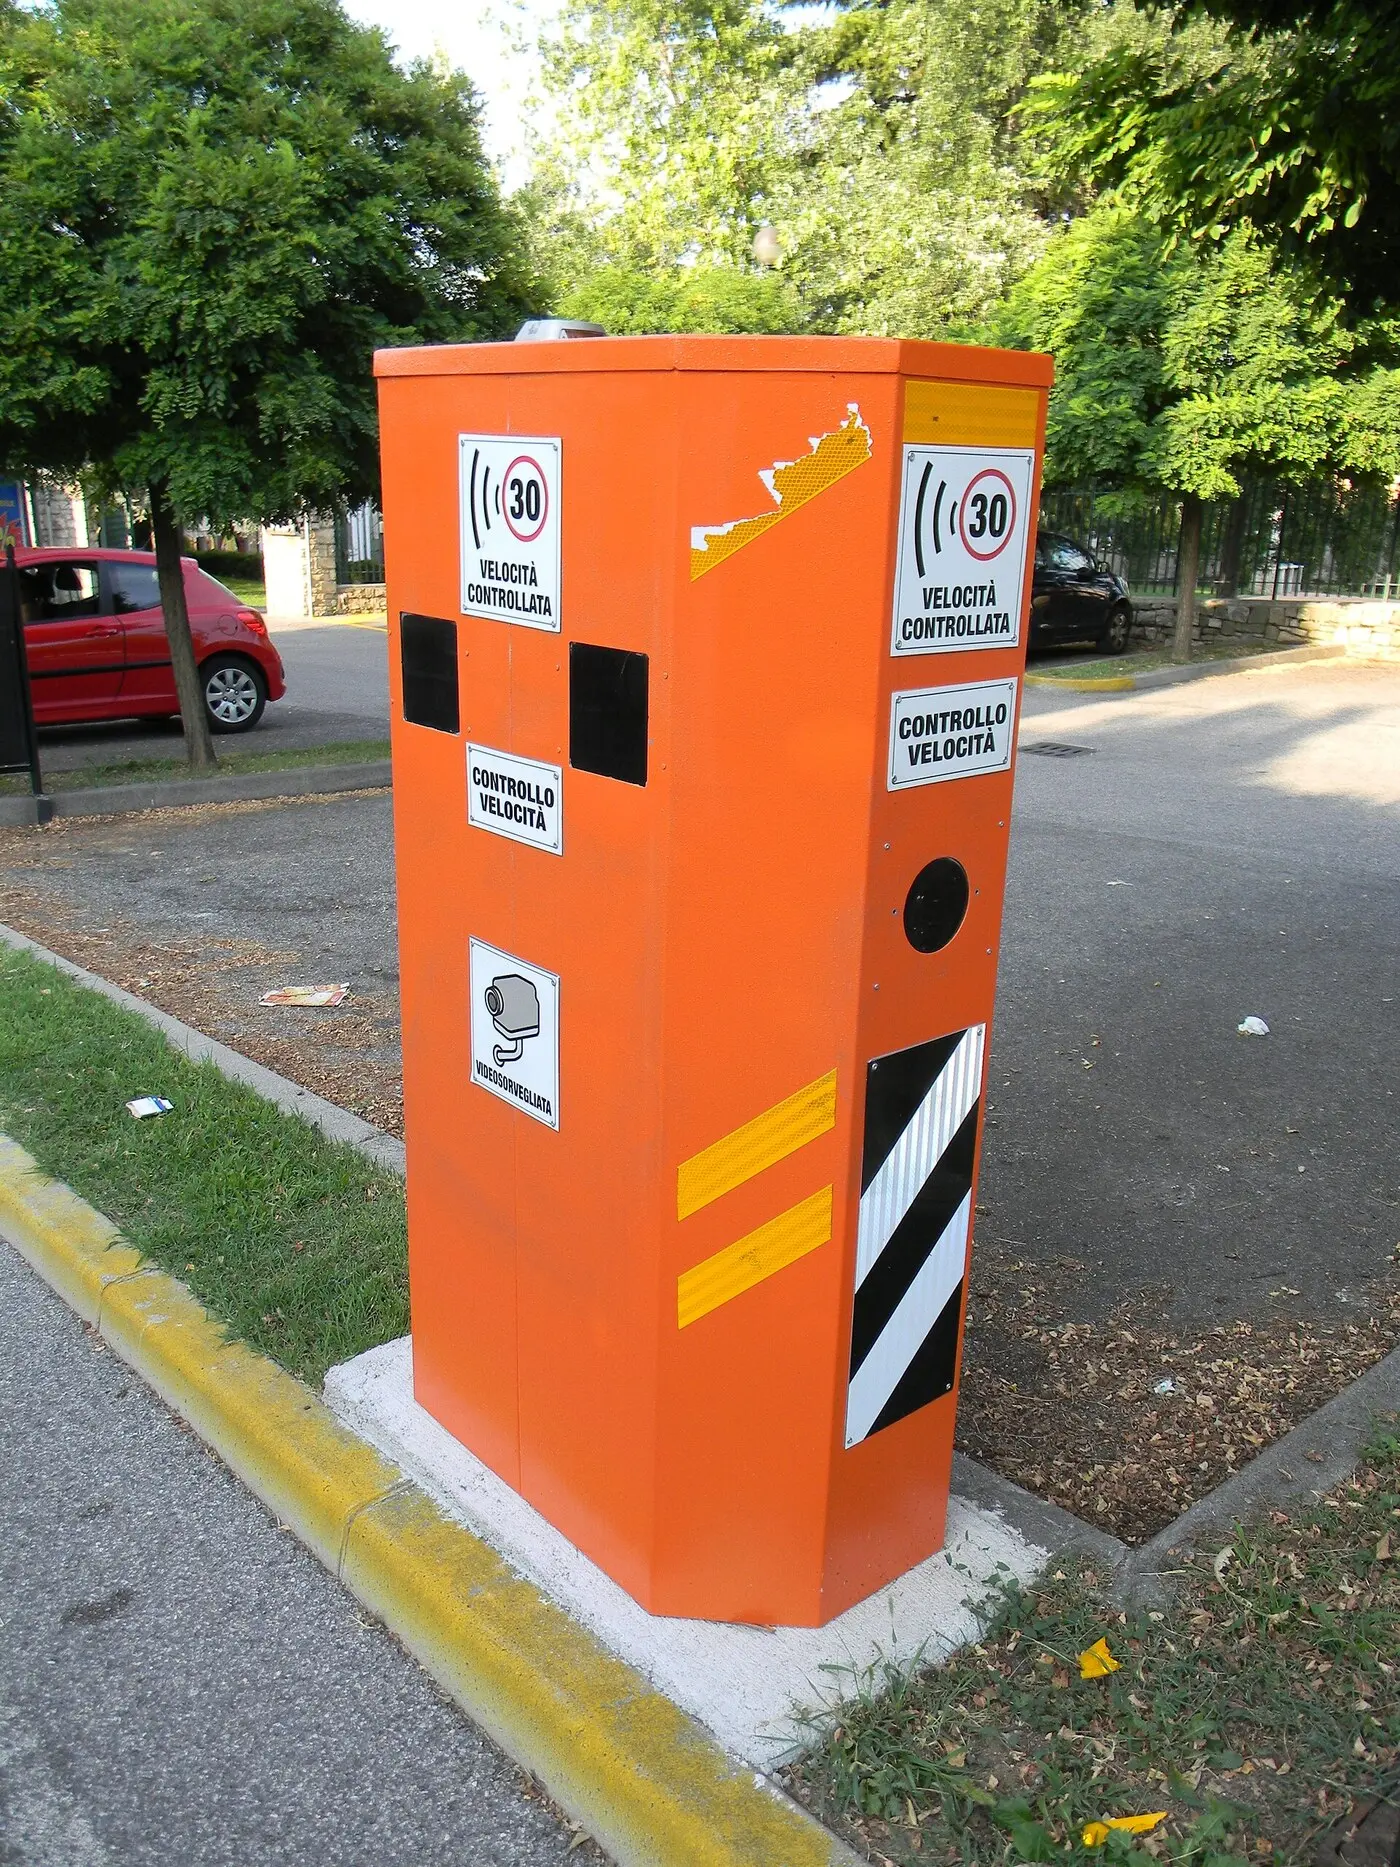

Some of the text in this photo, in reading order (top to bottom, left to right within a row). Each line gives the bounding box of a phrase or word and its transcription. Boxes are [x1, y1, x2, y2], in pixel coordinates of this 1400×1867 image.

[509, 478, 541, 521] 30
[968, 493, 1008, 538] 30
[479, 558, 538, 587] VELOCITÀ
[467, 582, 552, 617] CONTROLLATA
[922, 580, 997, 610] VELOCITÀ
[901, 612, 1011, 641] CONTROLLATA
[899, 703, 1007, 739] CONTROLLO
[908, 727, 996, 767] VELOCITÀ
[472, 766, 554, 808] CONTROLLO
[480, 793, 547, 832] VELOCITÀ
[475, 1059, 552, 1117] VIDEOSORVEGLIATA
